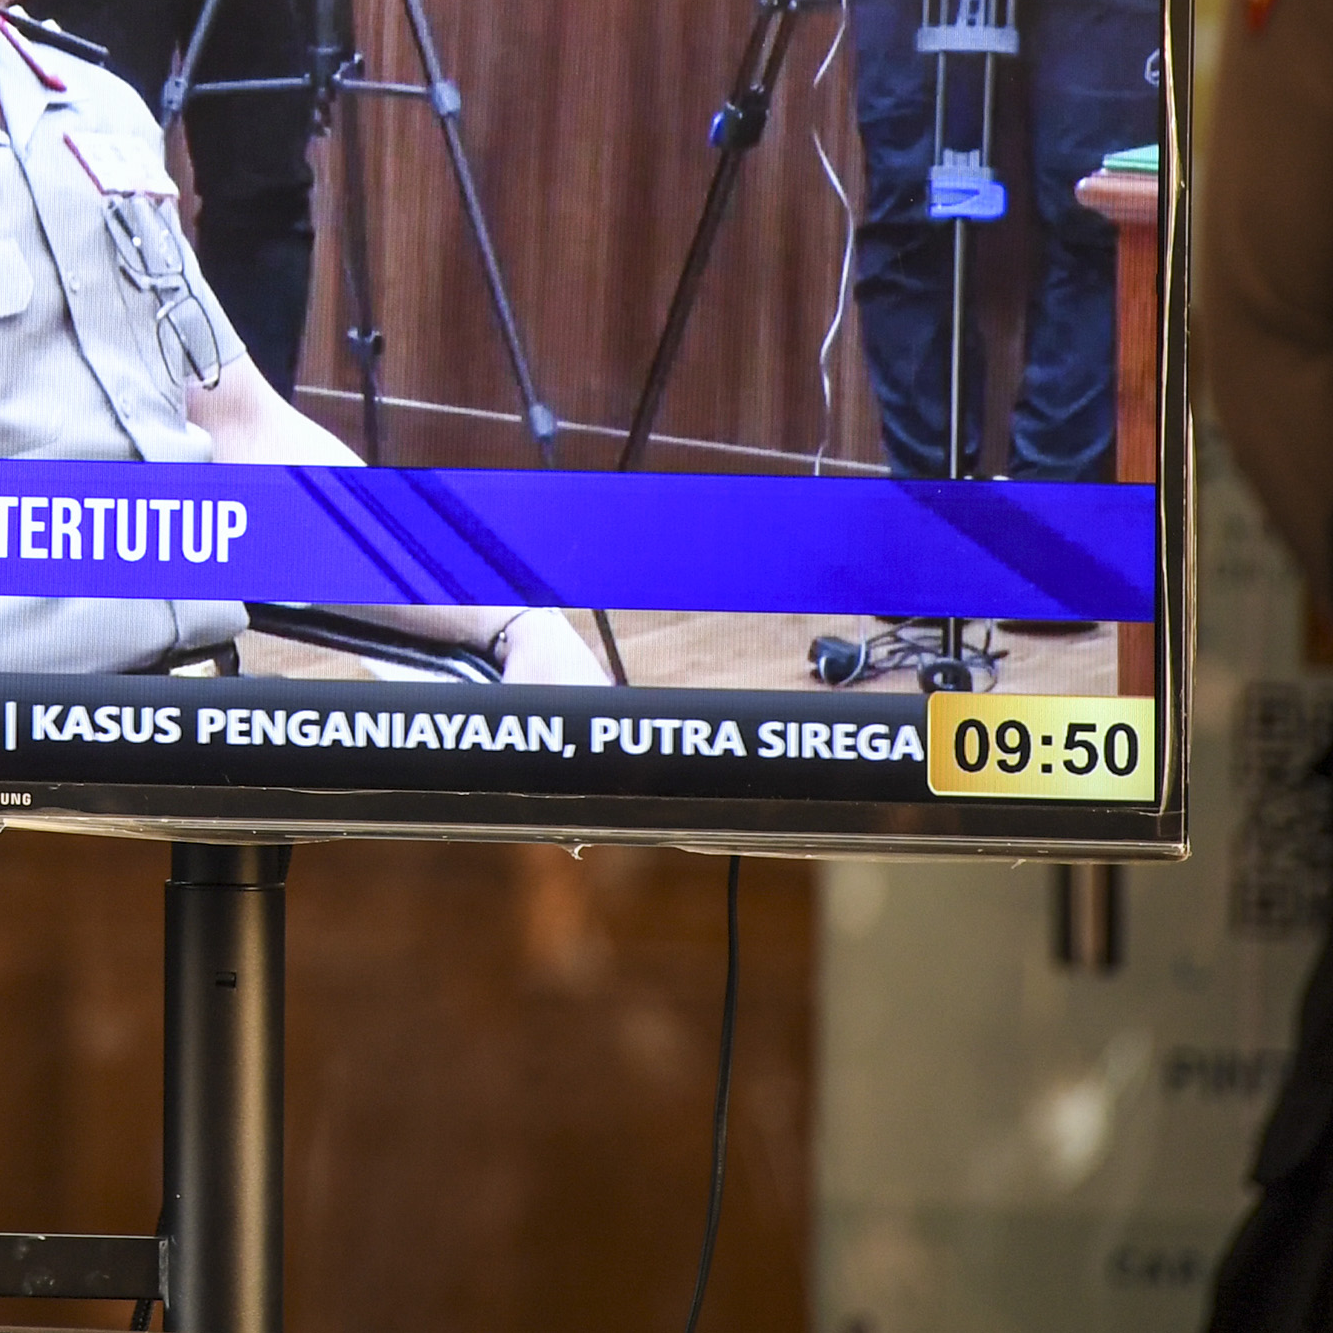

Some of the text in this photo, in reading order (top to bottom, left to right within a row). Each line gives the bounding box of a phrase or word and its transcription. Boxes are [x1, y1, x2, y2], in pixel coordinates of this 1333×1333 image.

[32, 704, 182, 745] KASUS
[197, 707, 576, 758] PENGANIAYAAN,
[591, 718, 747, 758] PUTRA
[757, 721, 925, 763] SIREGA
[954, 718, 1139, 777] 09:50
